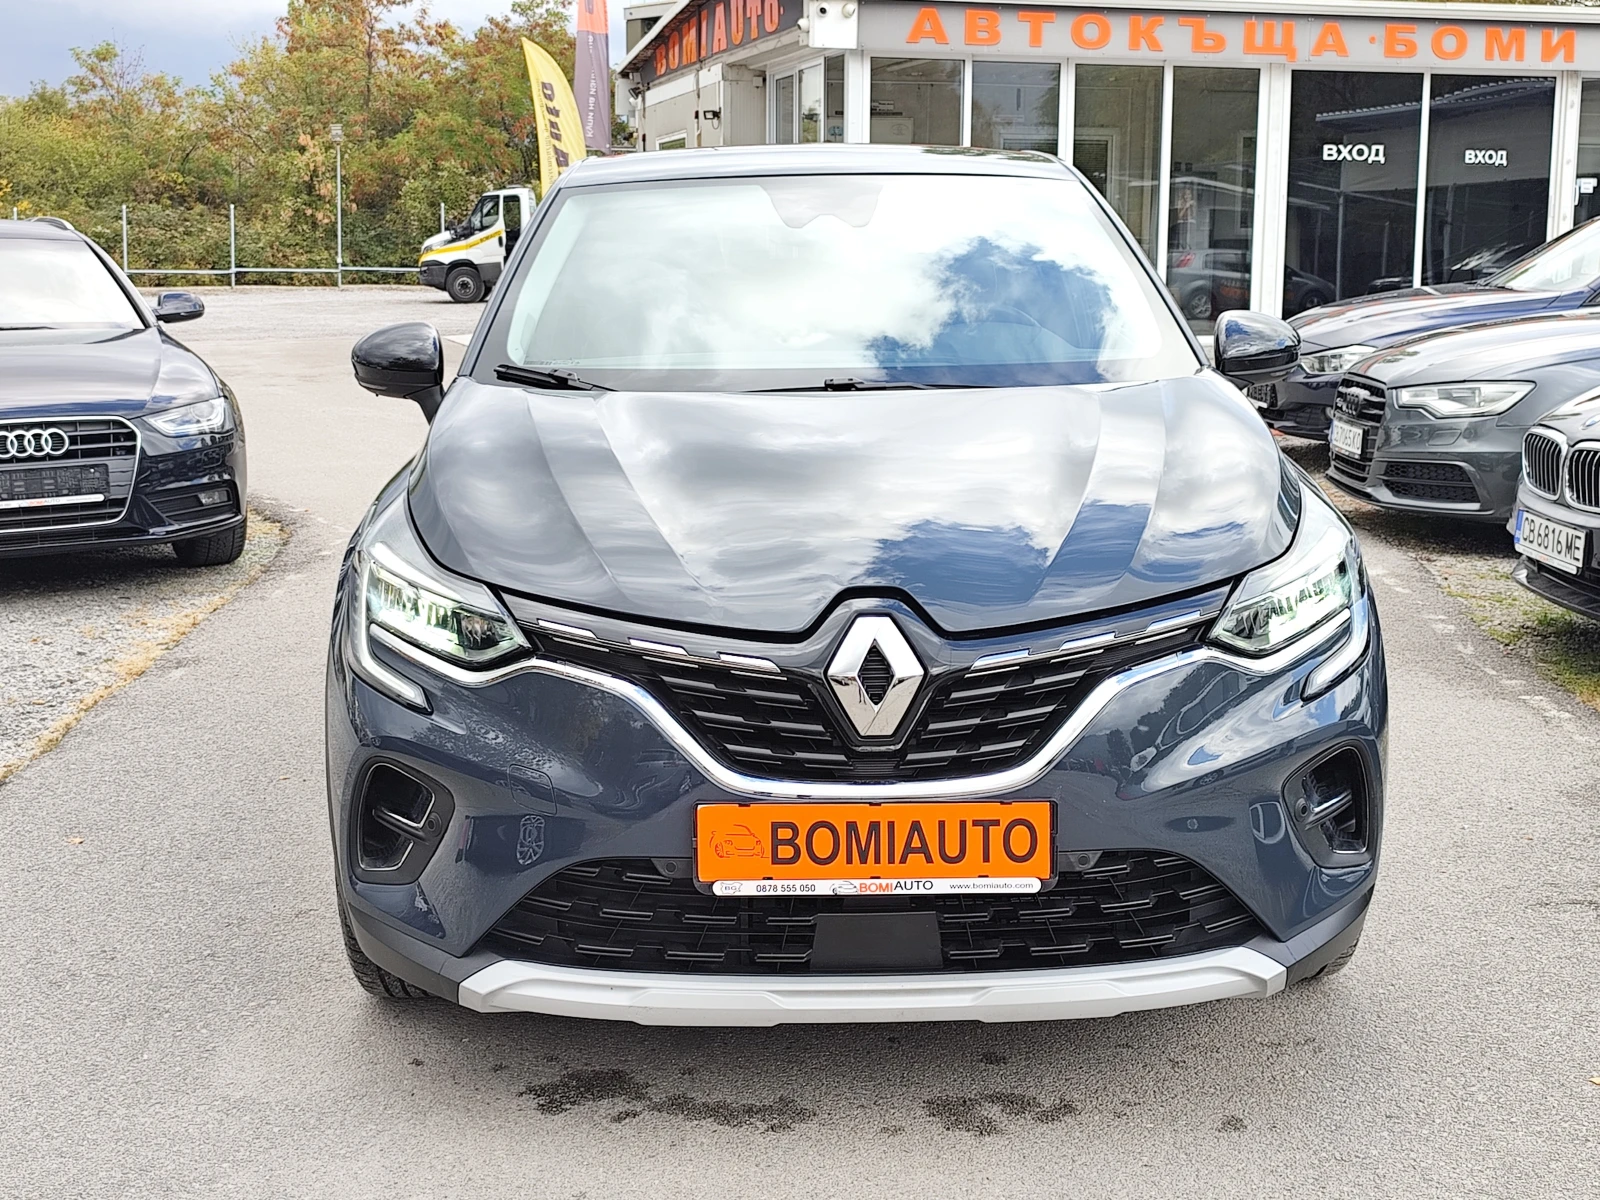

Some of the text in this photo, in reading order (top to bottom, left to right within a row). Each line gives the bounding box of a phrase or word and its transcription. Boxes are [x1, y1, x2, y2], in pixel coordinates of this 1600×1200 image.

[655, 0, 779, 76] BOMIAUTO
[906, 7, 1577, 63] АВТОКЪЩА БОМИ
[1322, 143, 1386, 164] ВХОД
[1464, 149, 1508, 166] ВХОД
[770, 818, 1038, 866] BOMIAUTO
[756, 884, 778, 893] 0878
[781, 884, 797, 893] 555
[799, 883, 816, 892] 050
[949, 881, 1034, 891] www.bomiauto.com
